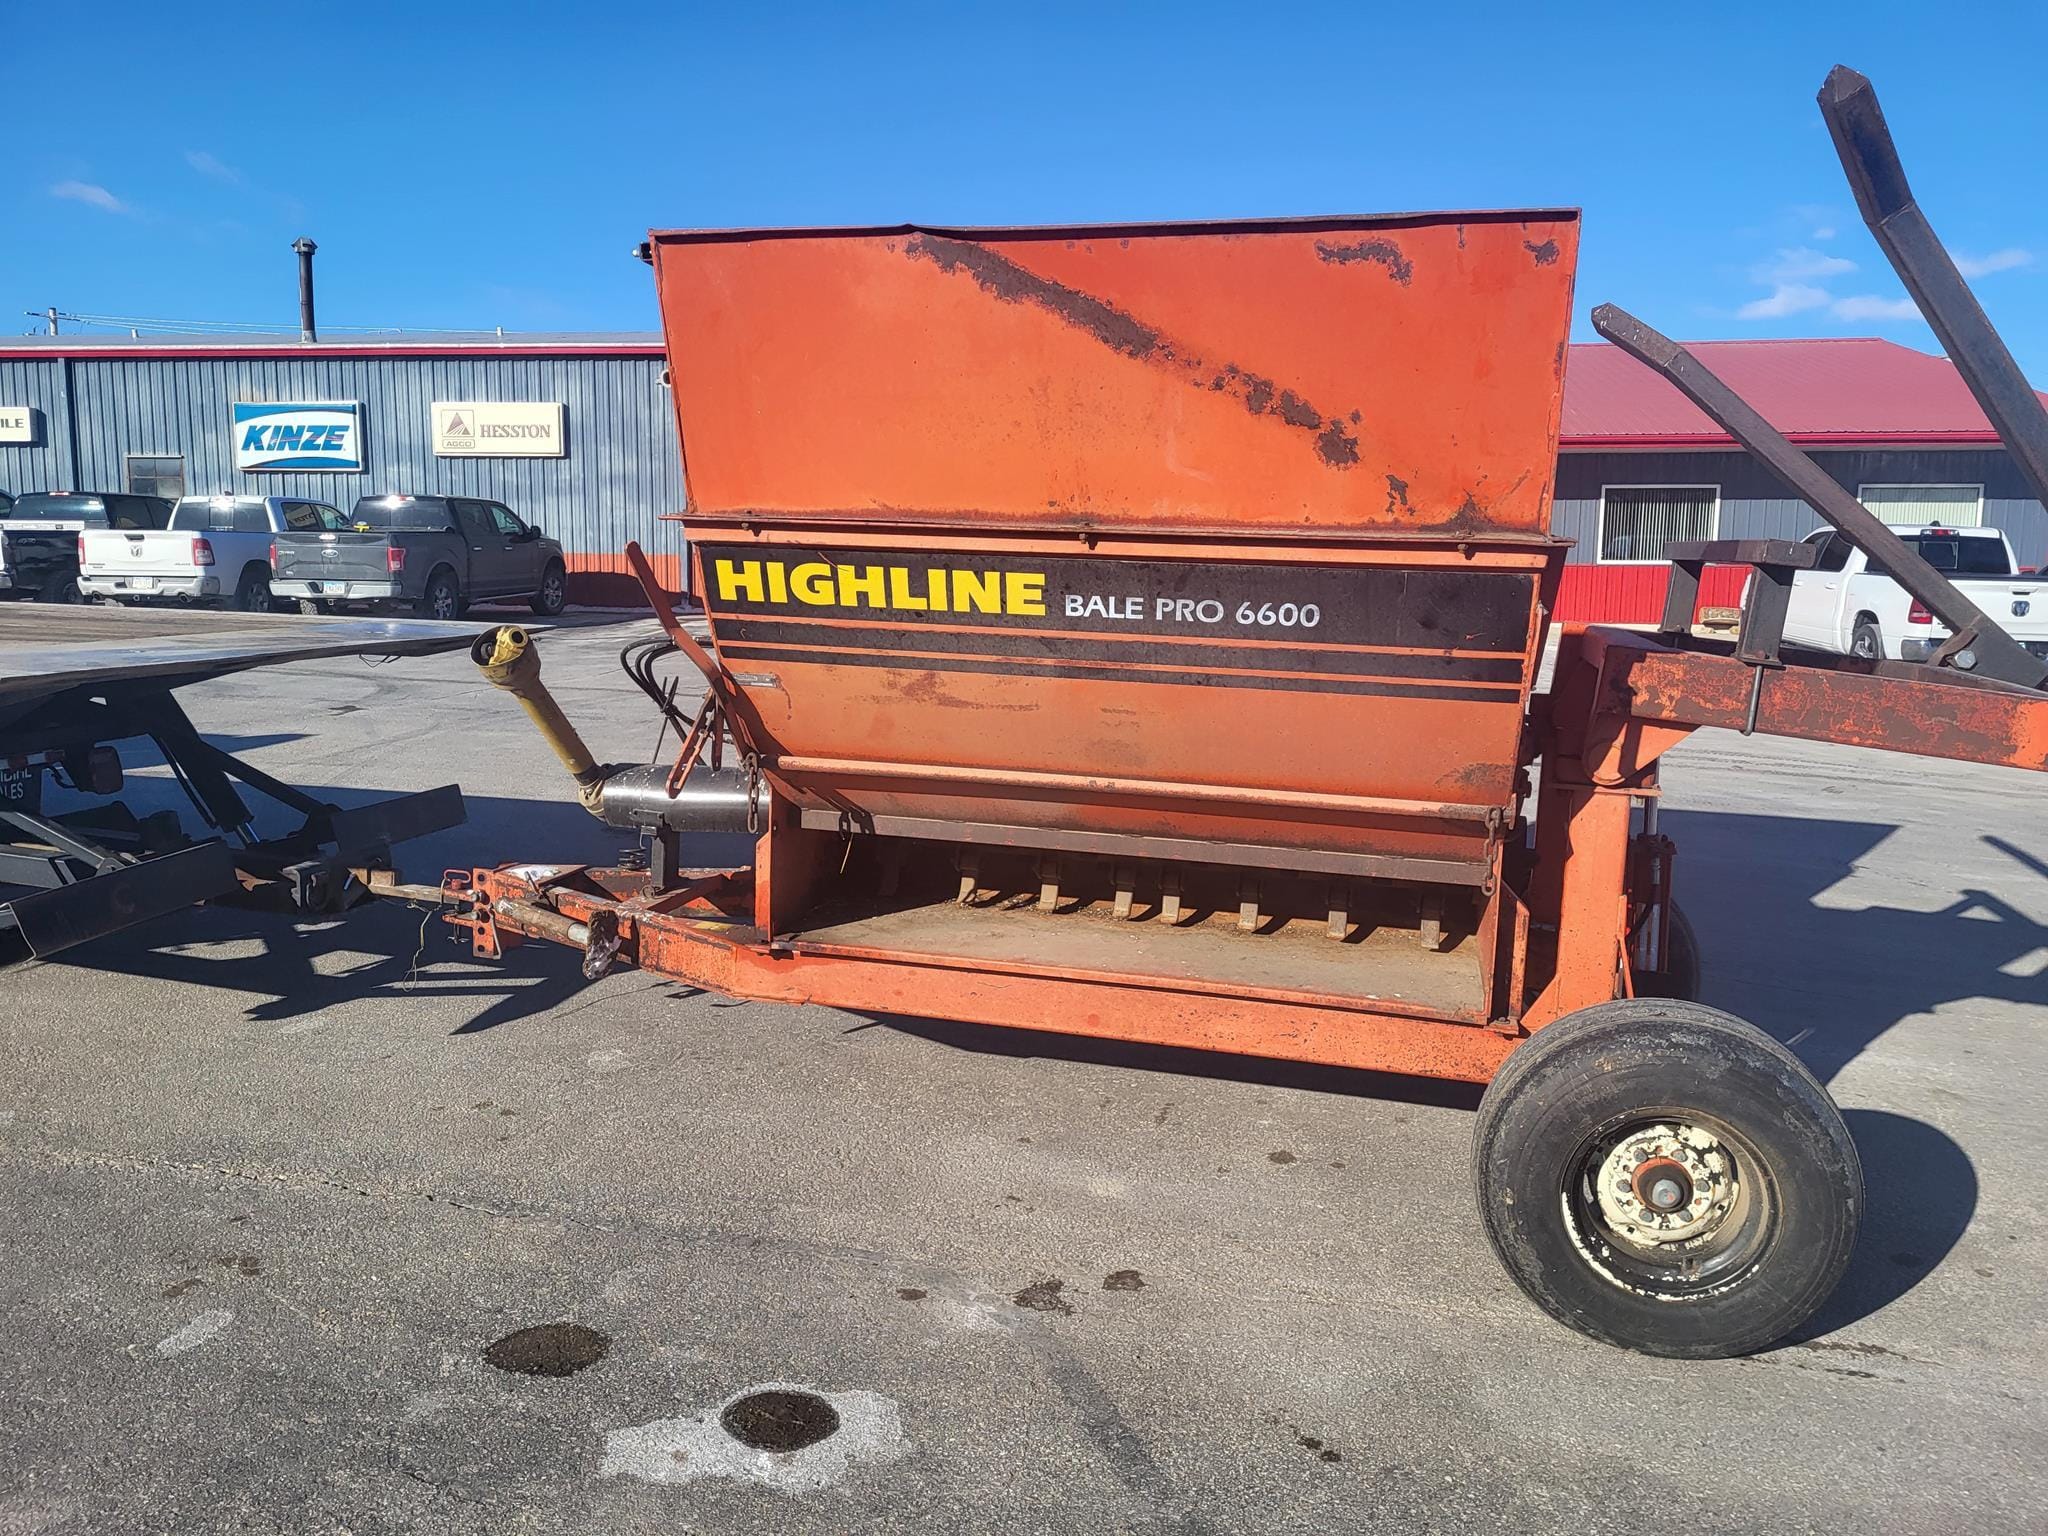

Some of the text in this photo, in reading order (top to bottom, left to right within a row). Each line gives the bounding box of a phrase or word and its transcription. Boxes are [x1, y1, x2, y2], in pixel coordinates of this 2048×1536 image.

[241, 425, 350, 451] KINZE
[480, 424, 551, 438] HESSTON
[715, 559, 1321, 627] HIGHLINE BALE PRO 6600
